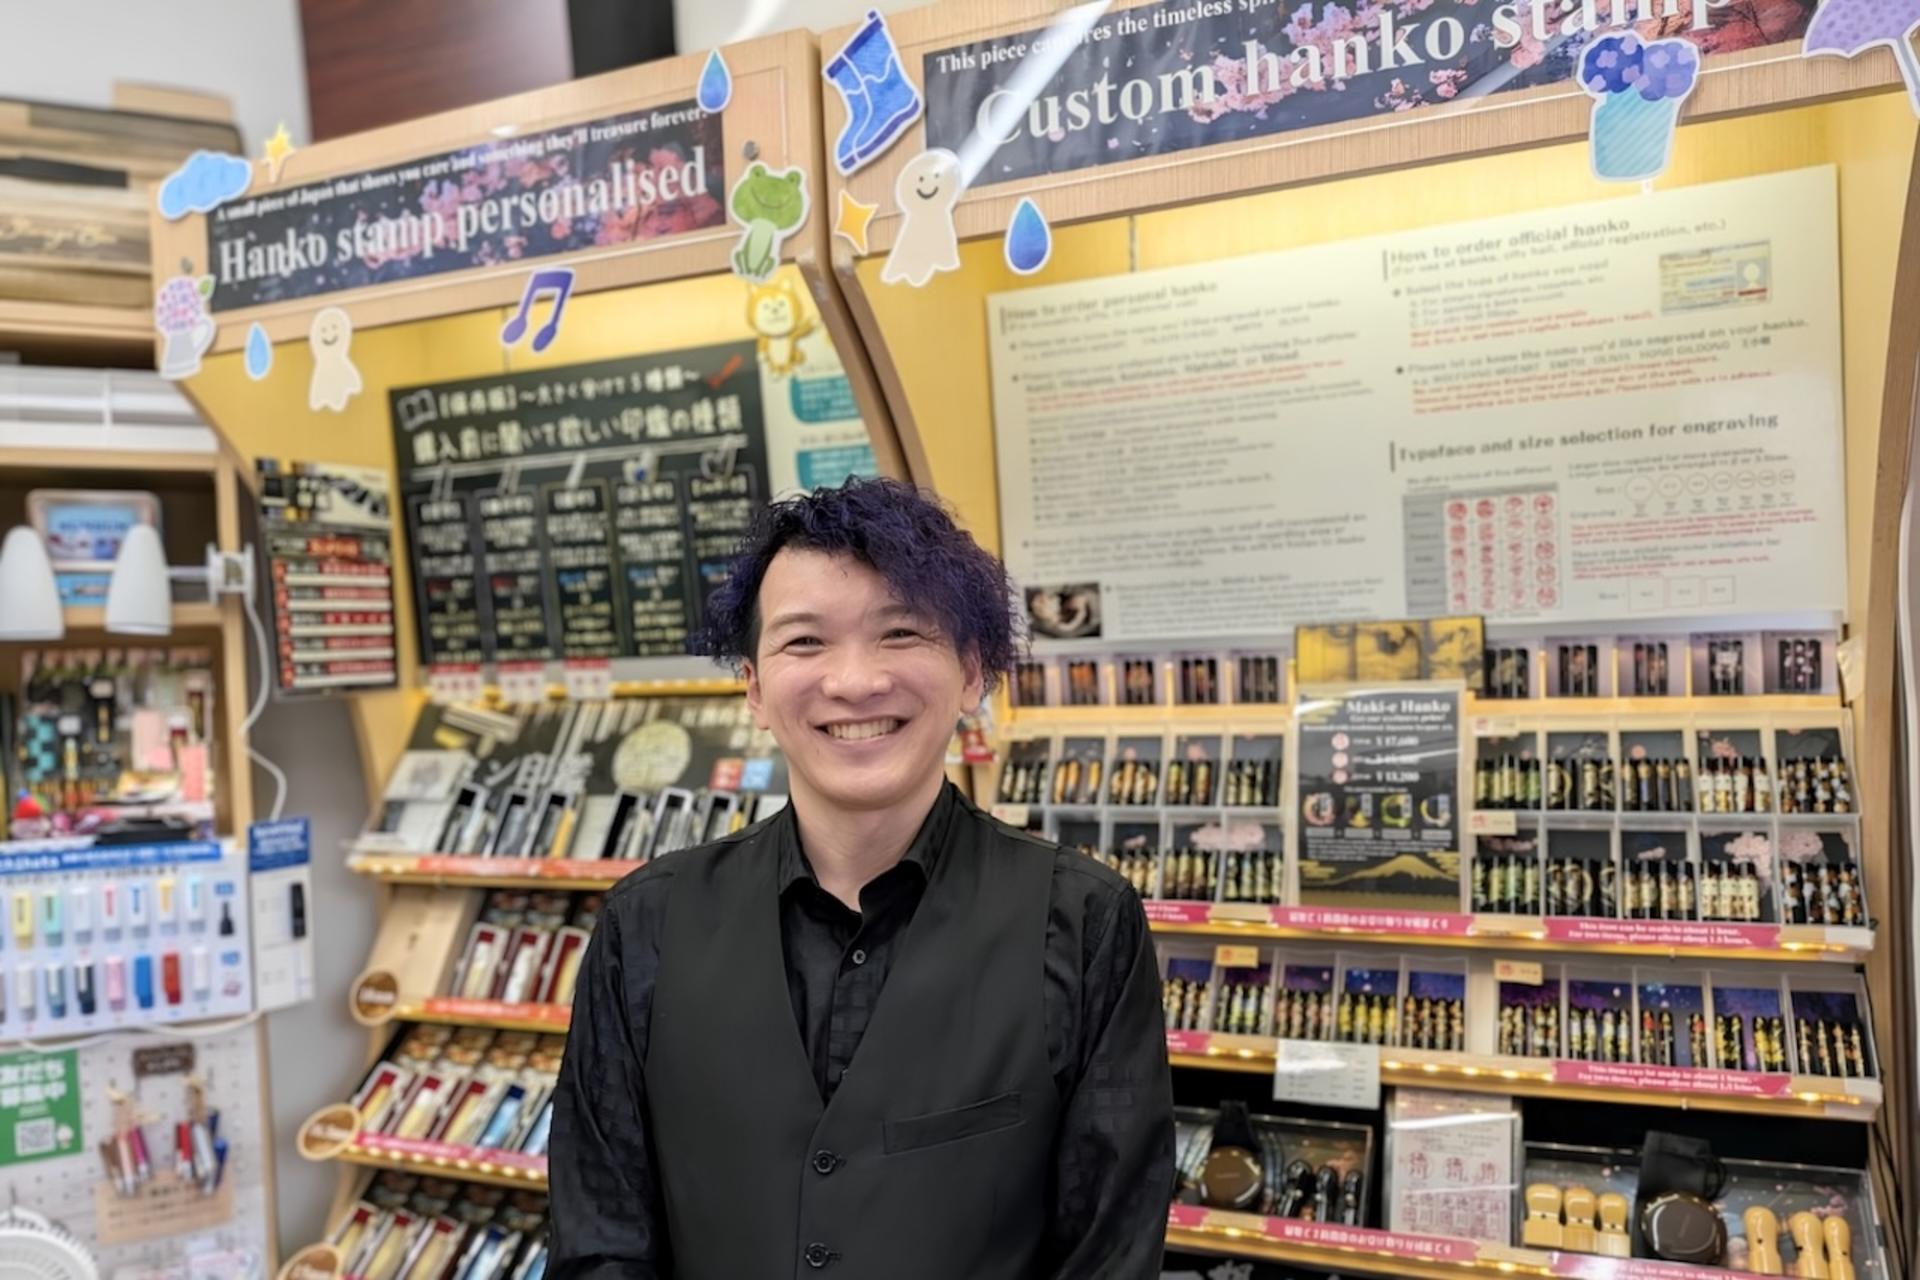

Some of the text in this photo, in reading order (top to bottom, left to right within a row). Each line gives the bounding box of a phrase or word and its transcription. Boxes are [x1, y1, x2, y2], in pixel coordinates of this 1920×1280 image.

[936, 53, 976, 75] This
[980, 43, 1027, 72] piece
[1116, 15, 1149, 37] the
[1152, 1, 1233, 30] timeless
[975, 61, 1217, 145] Custom
[1244, 14, 1466, 96] hanko
[216, 208, 226, 221] A
[226, 200, 256, 220] small
[257, 195, 285, 218] piece
[285, 190, 300, 208] of
[299, 184, 334, 208] Japan
[334, 179, 361, 199] that
[360, 171, 397, 193] shows
[397, 168, 421, 187] you
[422, 161, 450, 178] care
[477, 138, 544, 165] something
[590, 117, 649, 142] treasure
[219, 145, 709, 284] Hanko stamp personalised
[1391, 218, 1630, 265] How to order official hanko
[1399, 413, 1780, 463] Typeface and size selection for engraving
[1346, 699, 1452, 714] Maki-e Hanko
